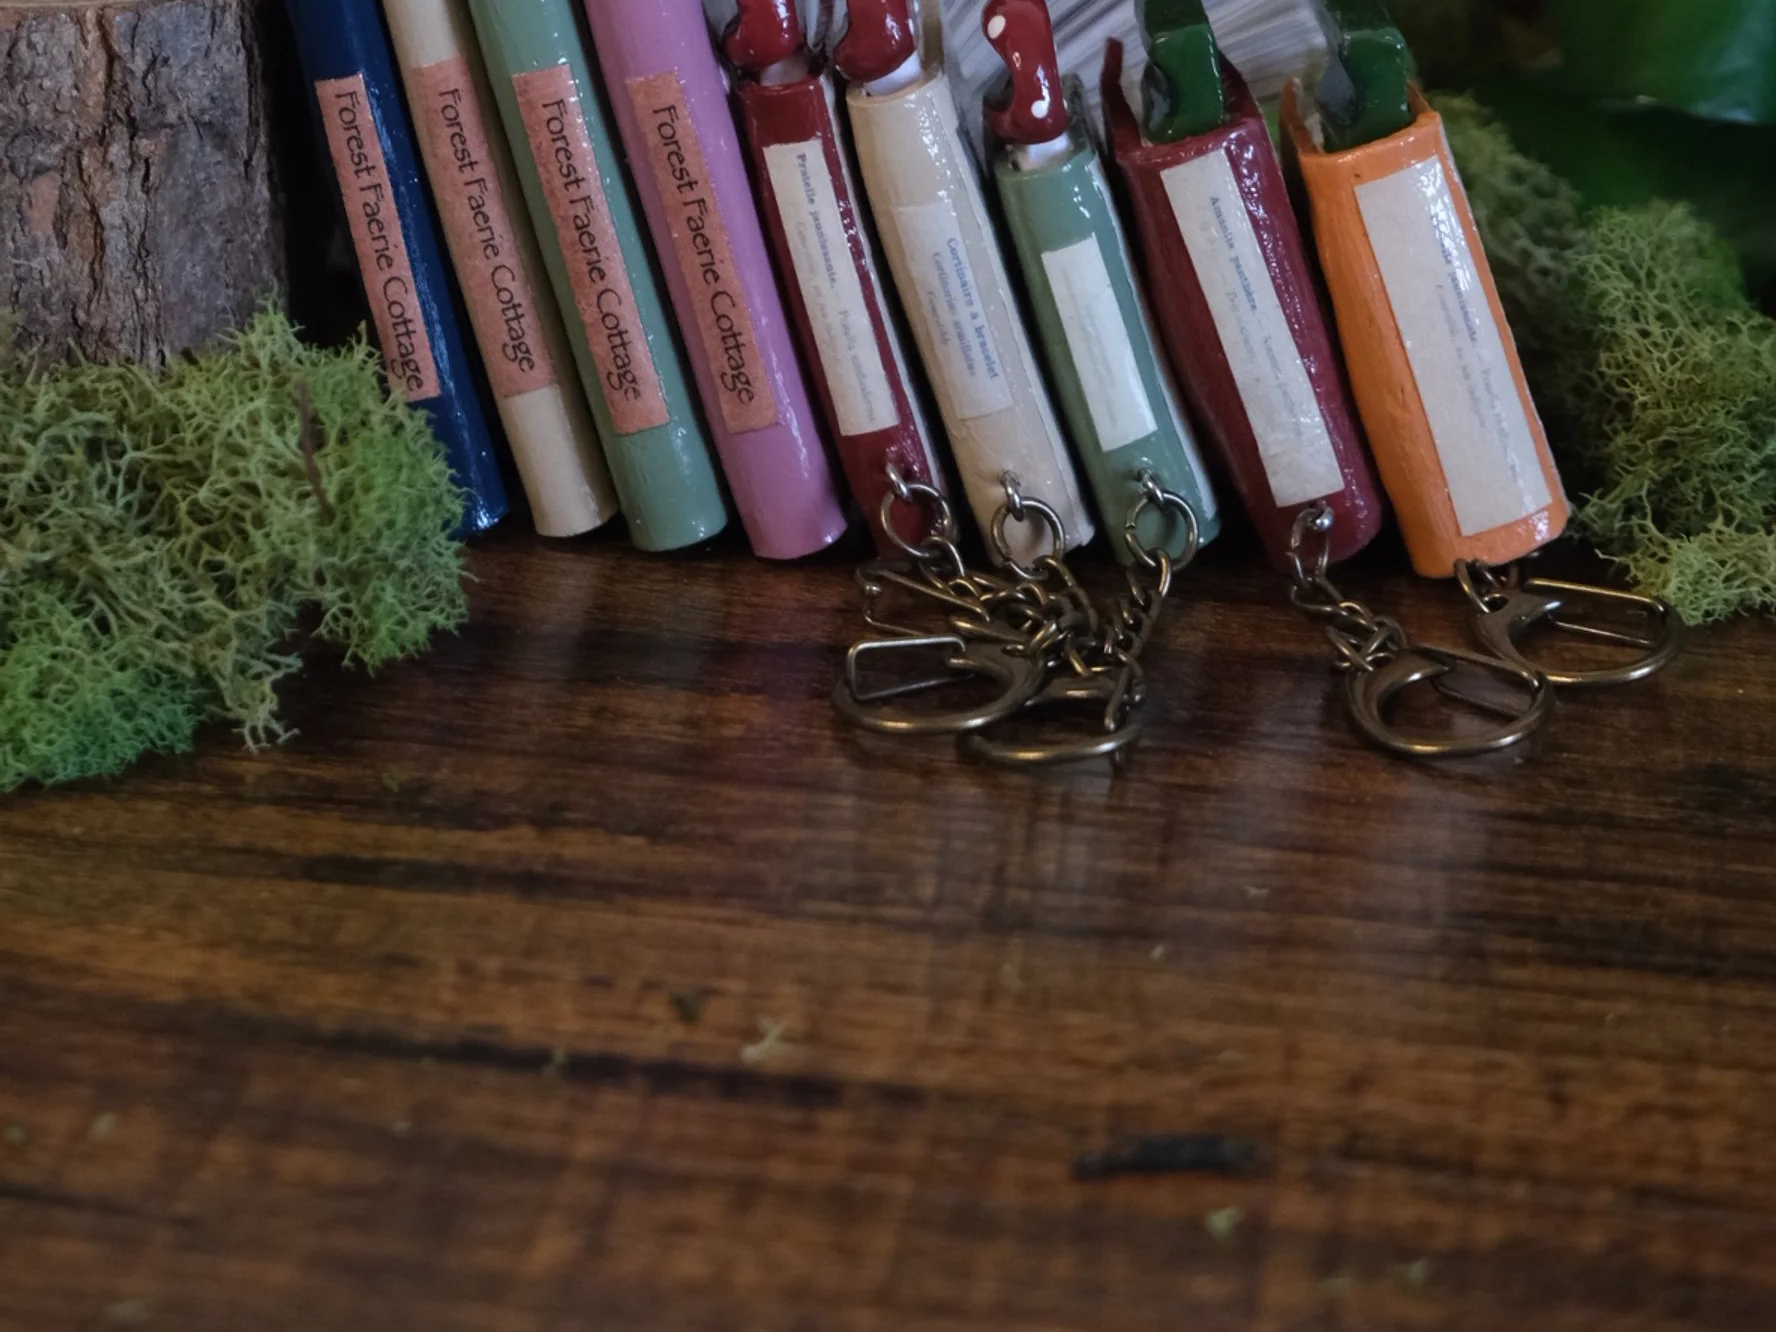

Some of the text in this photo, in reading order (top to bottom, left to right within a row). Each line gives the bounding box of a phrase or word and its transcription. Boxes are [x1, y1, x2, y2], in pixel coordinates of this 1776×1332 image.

[335, 91, 424, 391] Forest Faerie Cottage
[438, 88, 535, 373] Forest Faerie Cottage
[542, 99, 640, 401] Forest Faerie Cottage
[653, 104, 754, 404] Forest Faerie Cottage
